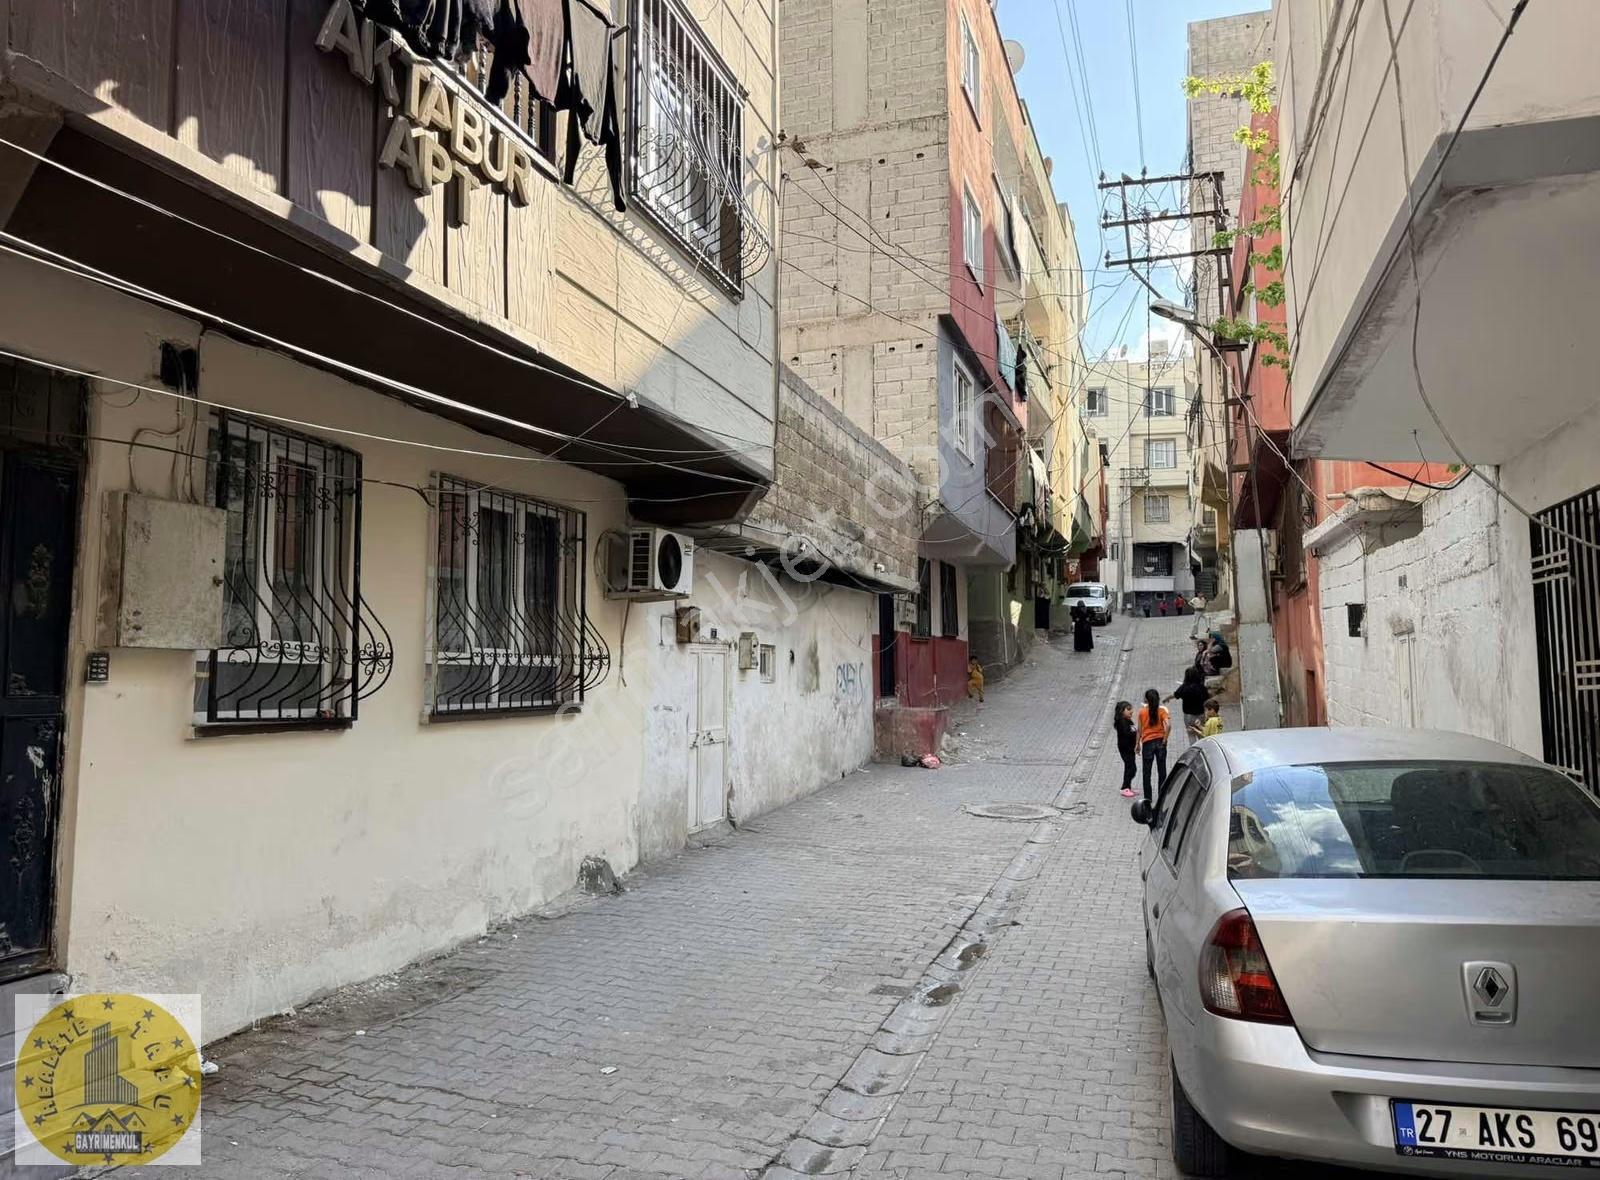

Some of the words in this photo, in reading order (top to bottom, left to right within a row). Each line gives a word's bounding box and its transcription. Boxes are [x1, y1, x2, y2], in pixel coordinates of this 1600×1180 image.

[379, 115, 480, 226] APT
[1400, 1127, 1415, 1138] TR
[1416, 1109, 1452, 1143] 27
[1479, 1112, 1535, 1149] AKS
[1556, 1117, 1600, 1153] 69
[1445, 1150, 1468, 1158] YNS
[1471, 1152, 1526, 1162] MOTORLU
